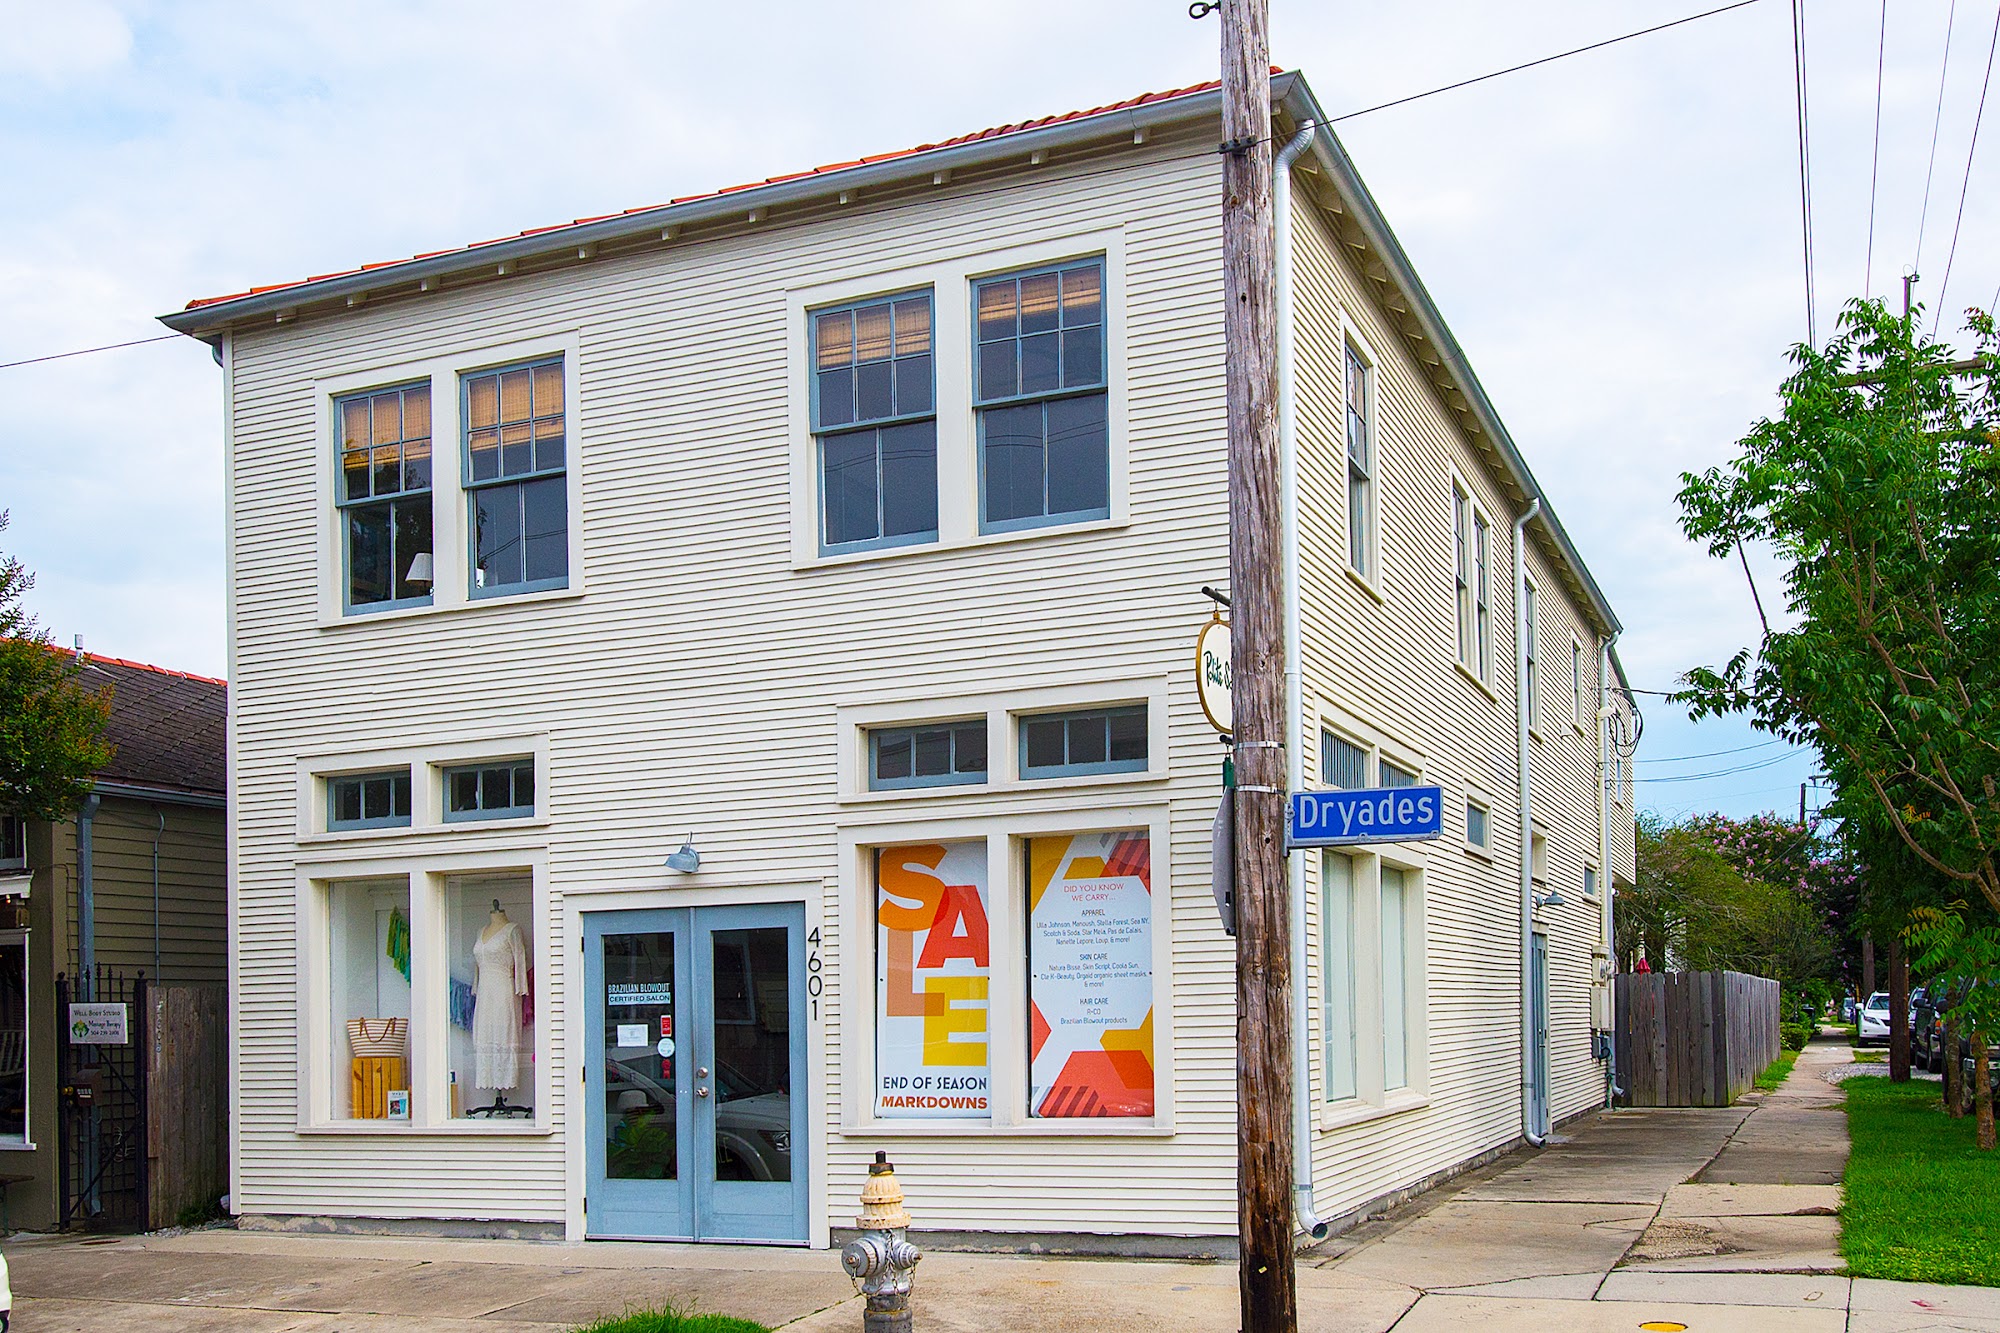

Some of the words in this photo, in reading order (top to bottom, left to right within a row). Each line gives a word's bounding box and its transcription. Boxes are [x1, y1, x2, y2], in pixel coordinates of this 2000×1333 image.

[1300, 792, 1434, 835] Dryades
[1063, 885, 1077, 893] DID
[1079, 884, 1097, 892] YOU
[1098, 883, 1124, 891] KNOW
[1131, 917, 1140, 925] Sea
[1082, 928, 1093, 936] Star
[1107, 927, 1117, 935] Pas
[1056, 938, 1076, 946] Nanette
[879, 844, 989, 1066] SALE
[807, 926, 823, 1021] 4601
[1094, 972, 1113, 980] organic
[608, 984, 639, 993] BRAZILIAN
[640, 983, 670, 993] BLOWOUT
[1083, 1017, 1104, 1025] Blowout
[1105, 1017, 1128, 1025] products
[883, 1076, 908, 1090] END
[912, 1076, 932, 1090] OF
[937, 1076, 987, 1090] SEASON
[881, 1096, 988, 1109] MARKDOWNS
